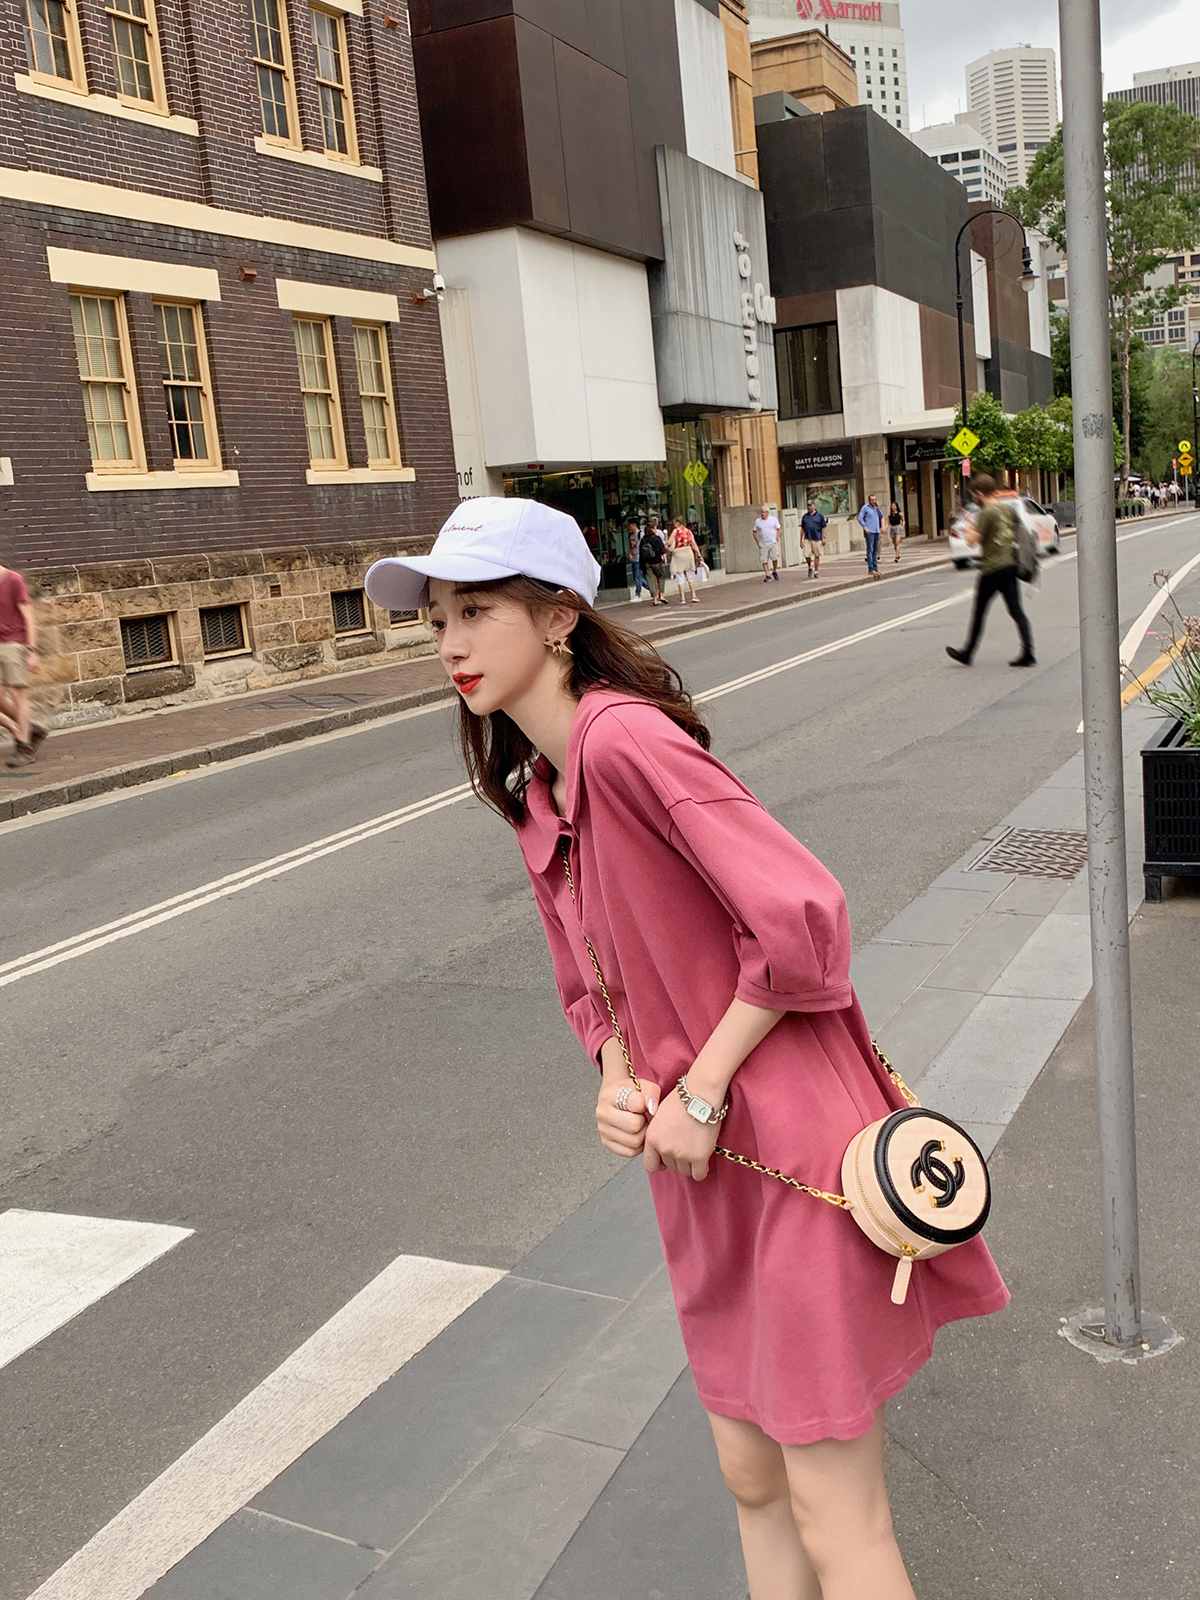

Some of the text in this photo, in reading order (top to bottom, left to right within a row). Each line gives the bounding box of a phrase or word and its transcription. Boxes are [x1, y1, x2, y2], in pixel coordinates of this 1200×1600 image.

[815, 0, 882, 21] Marriott
[813, 454, 842, 463] PEARSON
[464, 467, 473, 486] of
